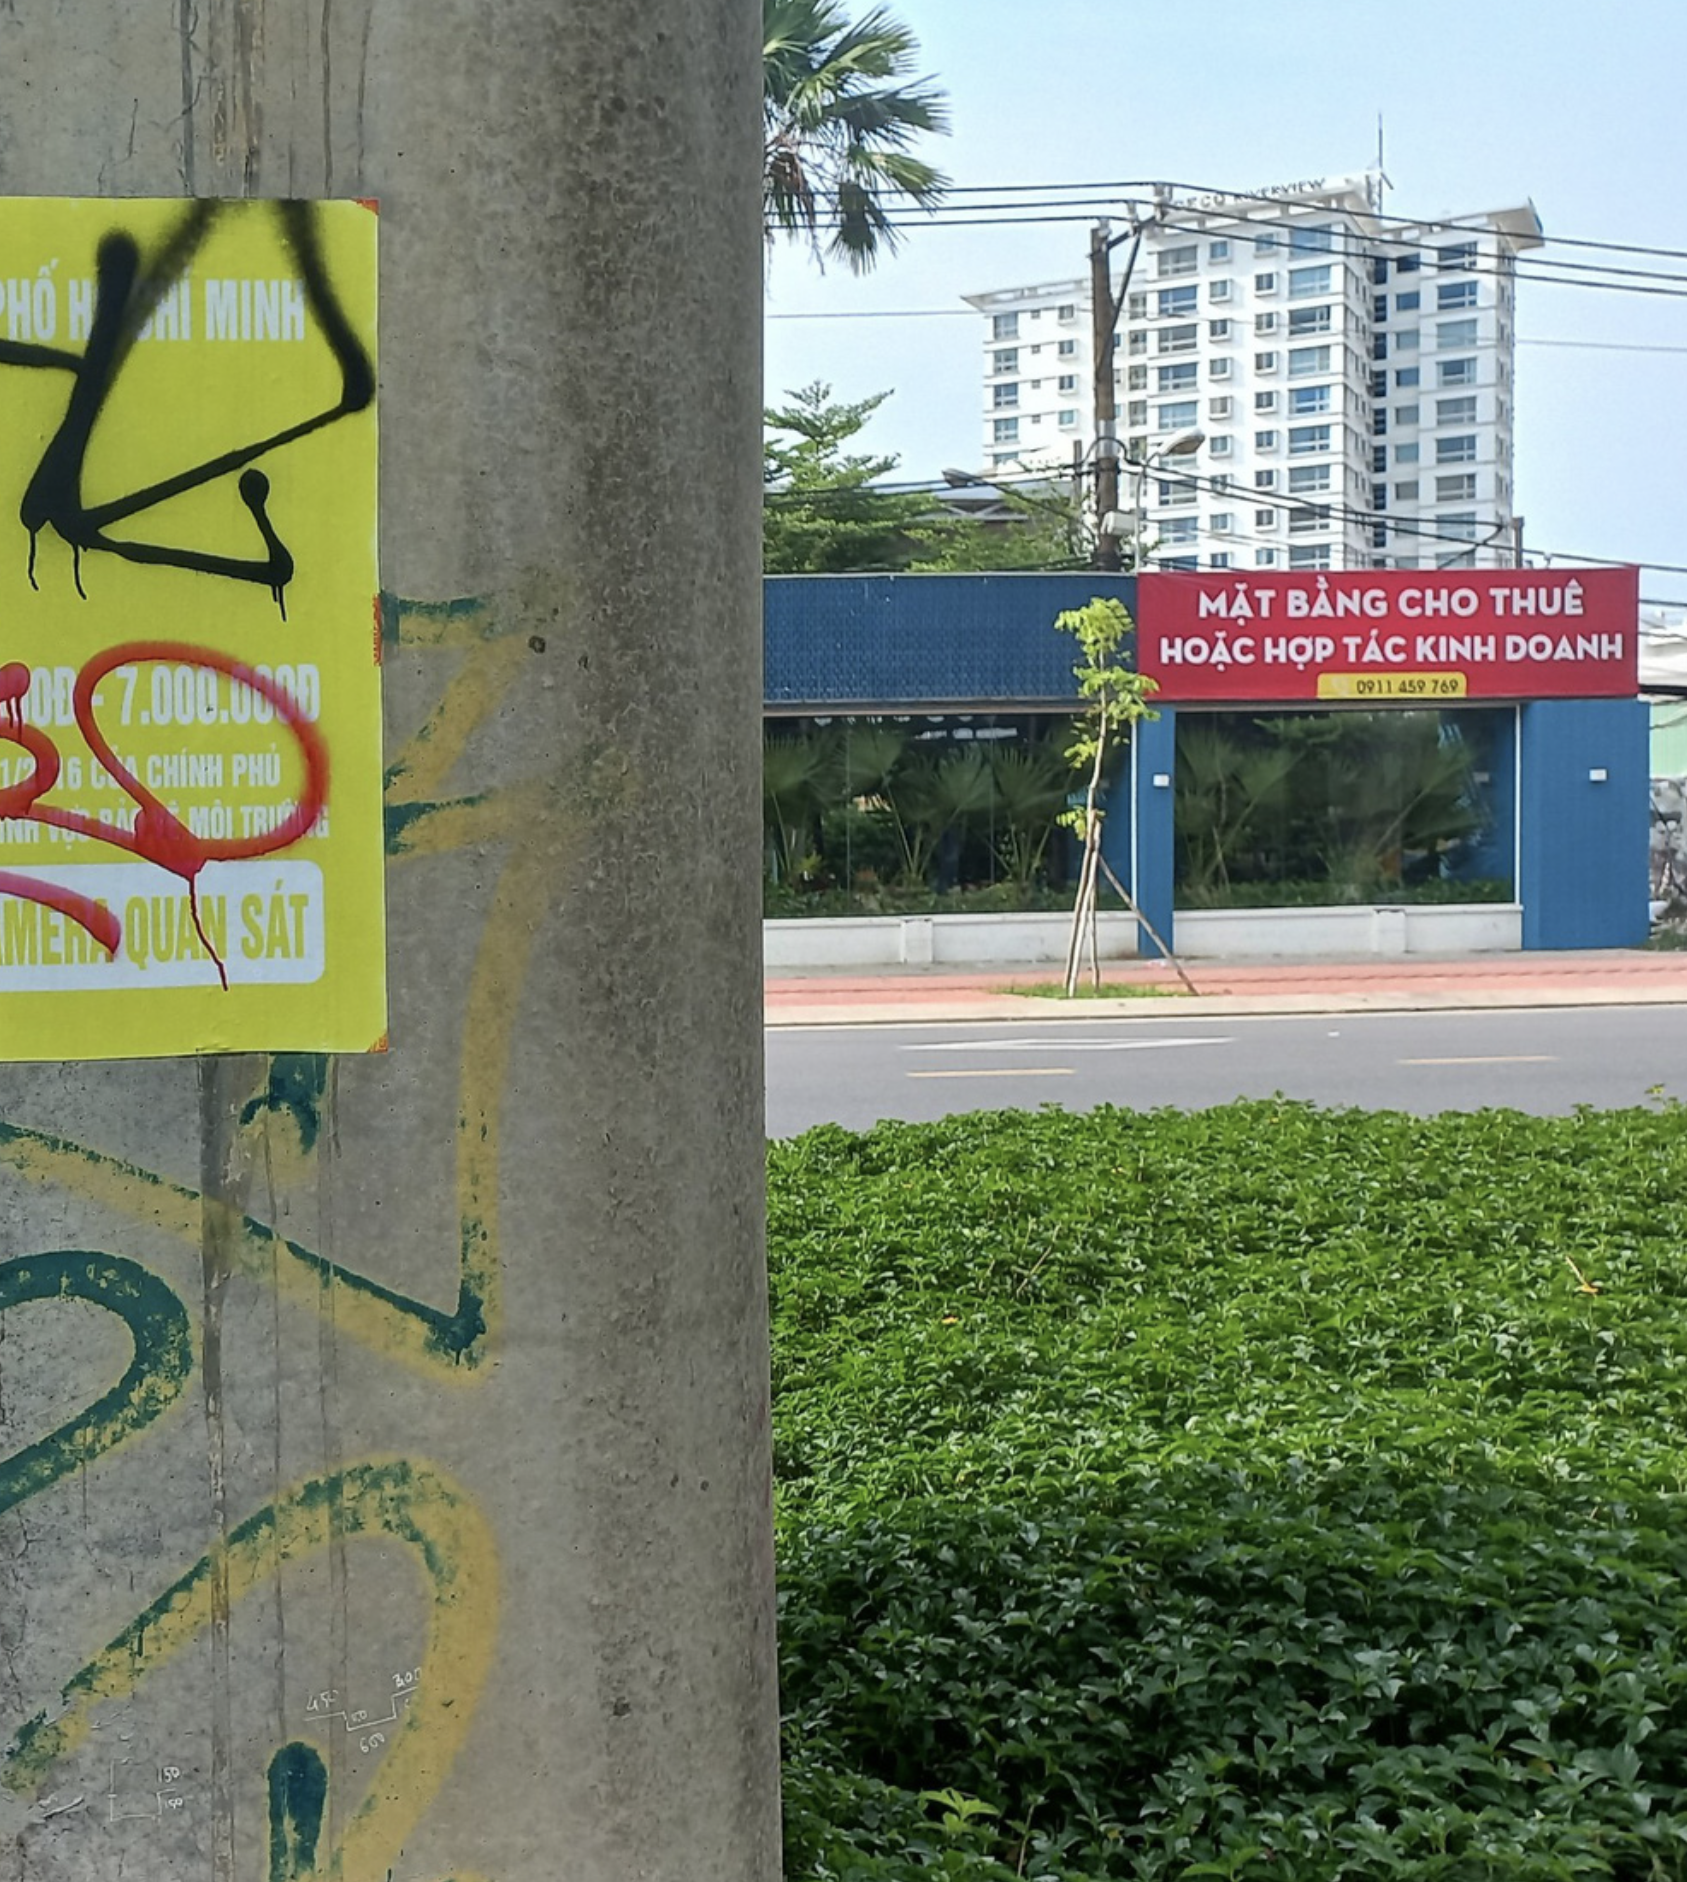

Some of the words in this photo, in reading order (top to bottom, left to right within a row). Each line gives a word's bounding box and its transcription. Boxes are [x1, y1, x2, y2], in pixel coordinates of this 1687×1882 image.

[205, 279, 305, 341] MINH
[1199, 582, 1276, 626] MẶT
[1287, 575, 1388, 618] BẰNG
[1398, 588, 1479, 617] CHO
[1489, 578, 1583, 616] THUÊ
[1160, 630, 1255, 672] HOẶC
[1264, 636, 1335, 671] HỢP
[1343, 628, 1407, 663] TÁC
[1416, 635, 1495, 663] KINH
[1505, 633, 1623, 661] DOANH
[1432, 679, 1459, 695] 769
[147, 746, 223, 789] CHÍNH
[232, 743, 281, 787] PHỦ
[188, 798, 233, 839] MÔI
[125, 895, 227, 970] QUAN
[240, 879, 309, 960] SÁT
